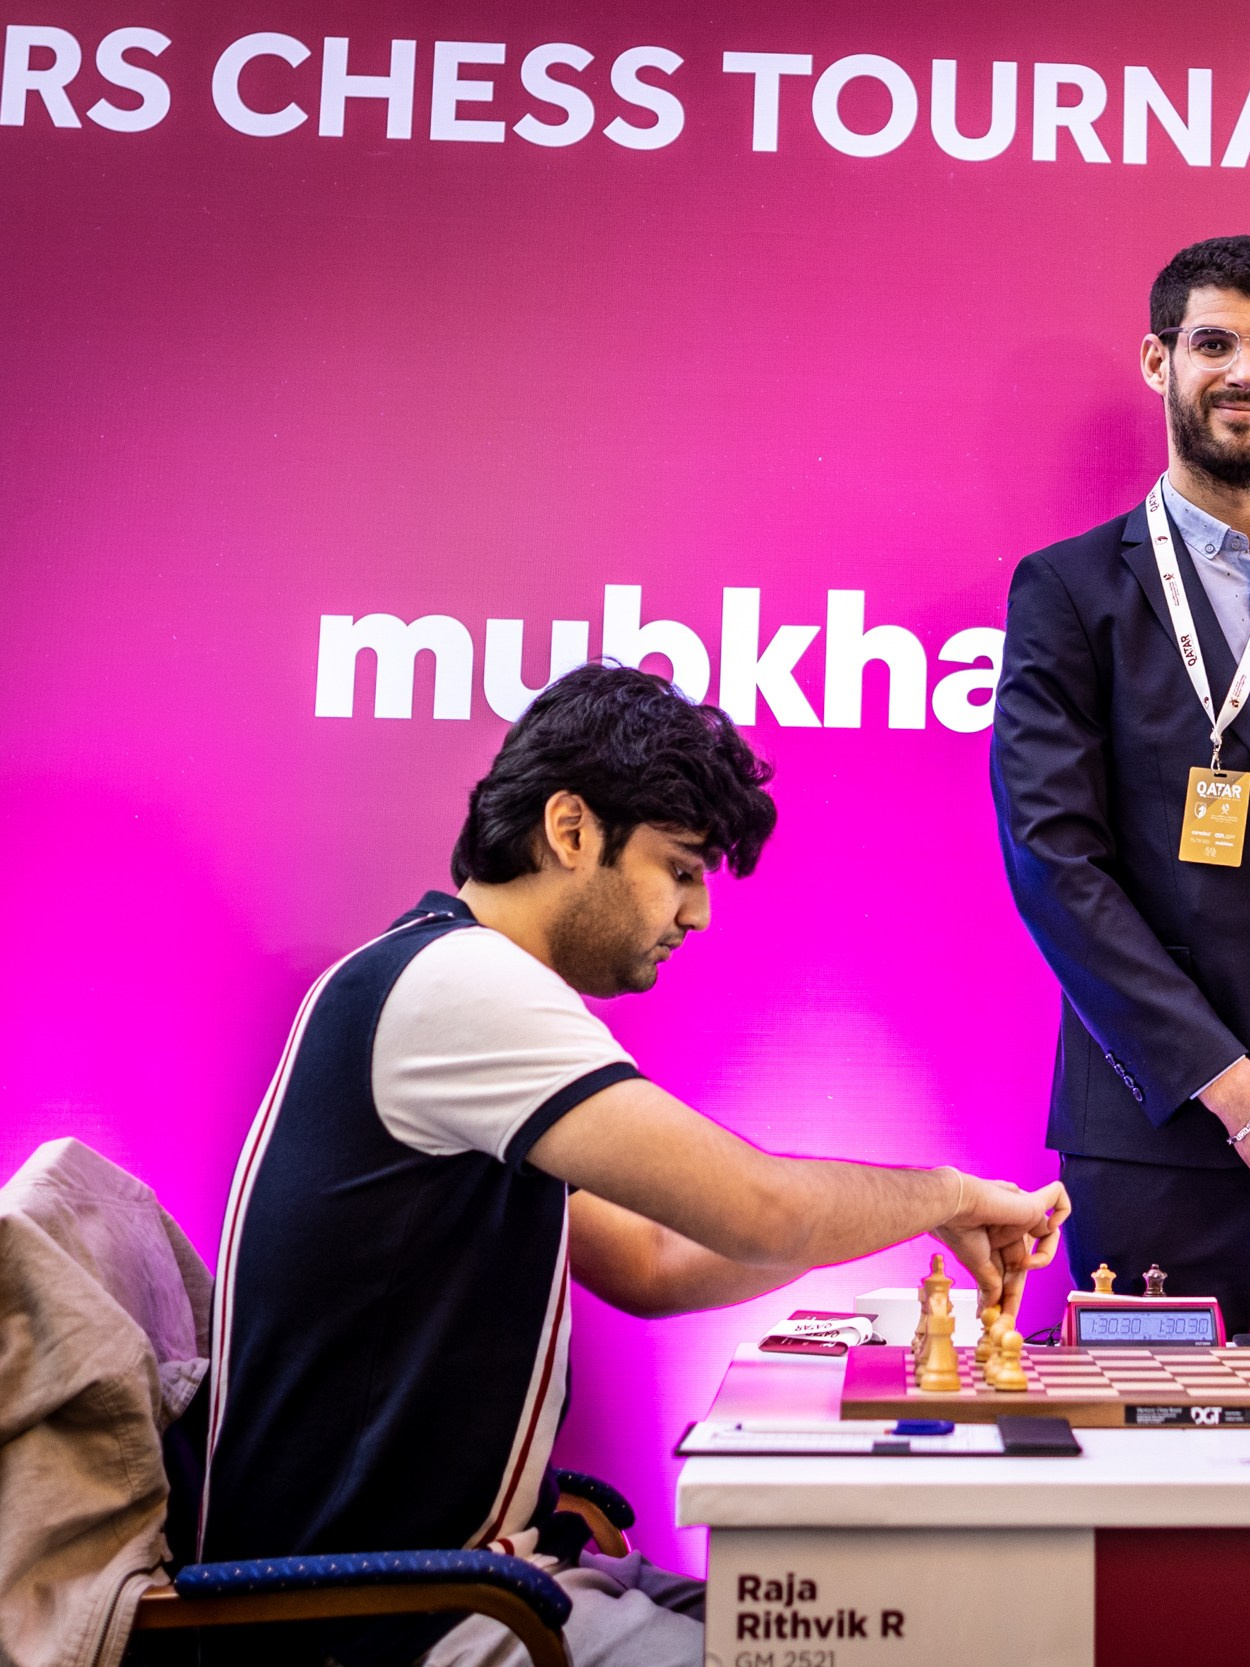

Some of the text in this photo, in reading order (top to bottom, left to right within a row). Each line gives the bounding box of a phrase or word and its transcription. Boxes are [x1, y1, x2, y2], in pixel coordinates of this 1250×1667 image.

[0, 25, 171, 132] RS
[212, 33, 684, 149] CHESS
[1180, 634, 1198, 667] QATAR
[1197, 781, 1242, 799] QATAR
[1190, 1406, 1223, 1425] DGT
[737, 1572, 818, 1608] Raja
[736, 1608, 905, 1640] Rithvik R
[734, 1650, 775, 1667] GM
